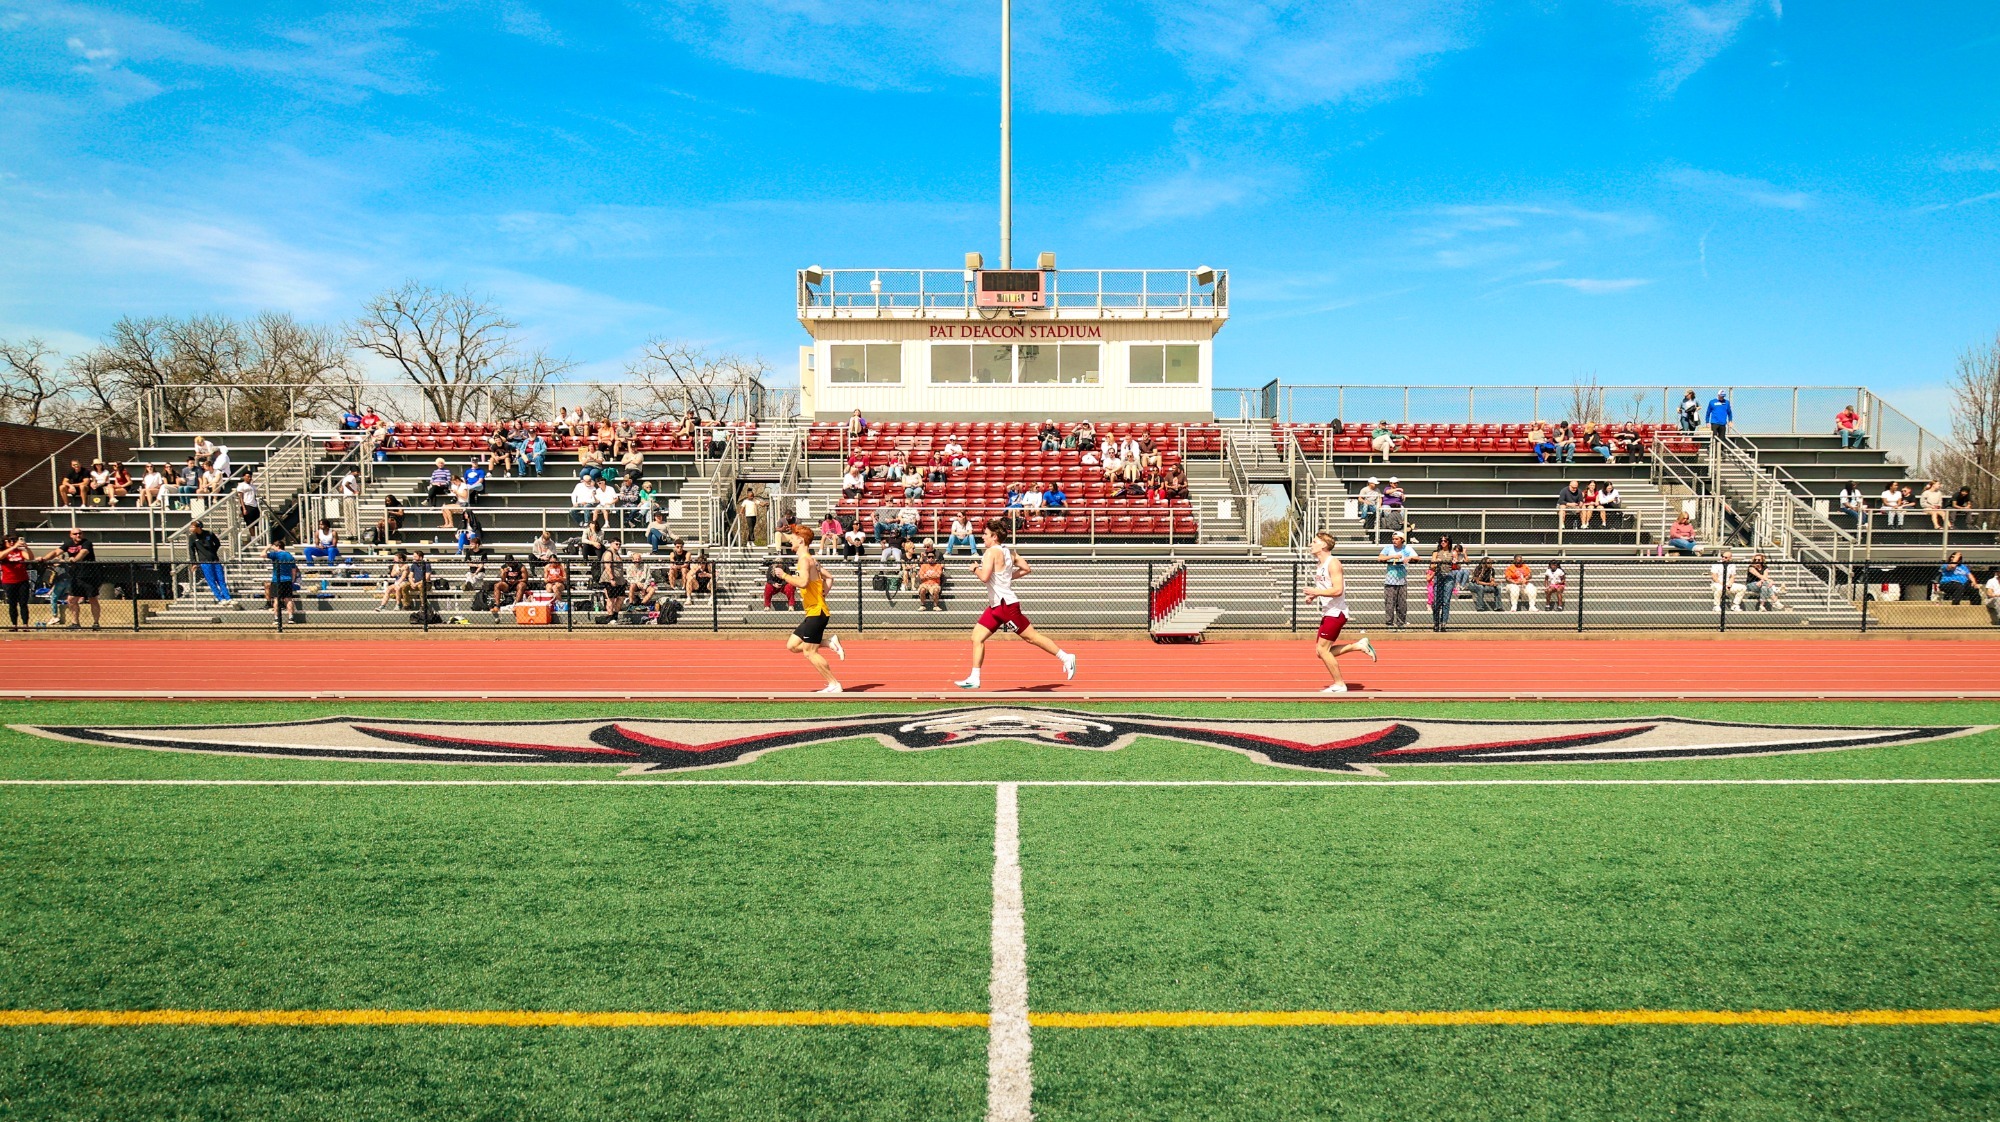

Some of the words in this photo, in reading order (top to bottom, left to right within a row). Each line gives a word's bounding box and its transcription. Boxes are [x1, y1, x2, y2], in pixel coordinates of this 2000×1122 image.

[929, 325, 956, 338] PAT
[960, 325, 1024, 338] DEACON
[1030, 325, 1102, 338] STADIUM
[527, 607, 536, 617] G
